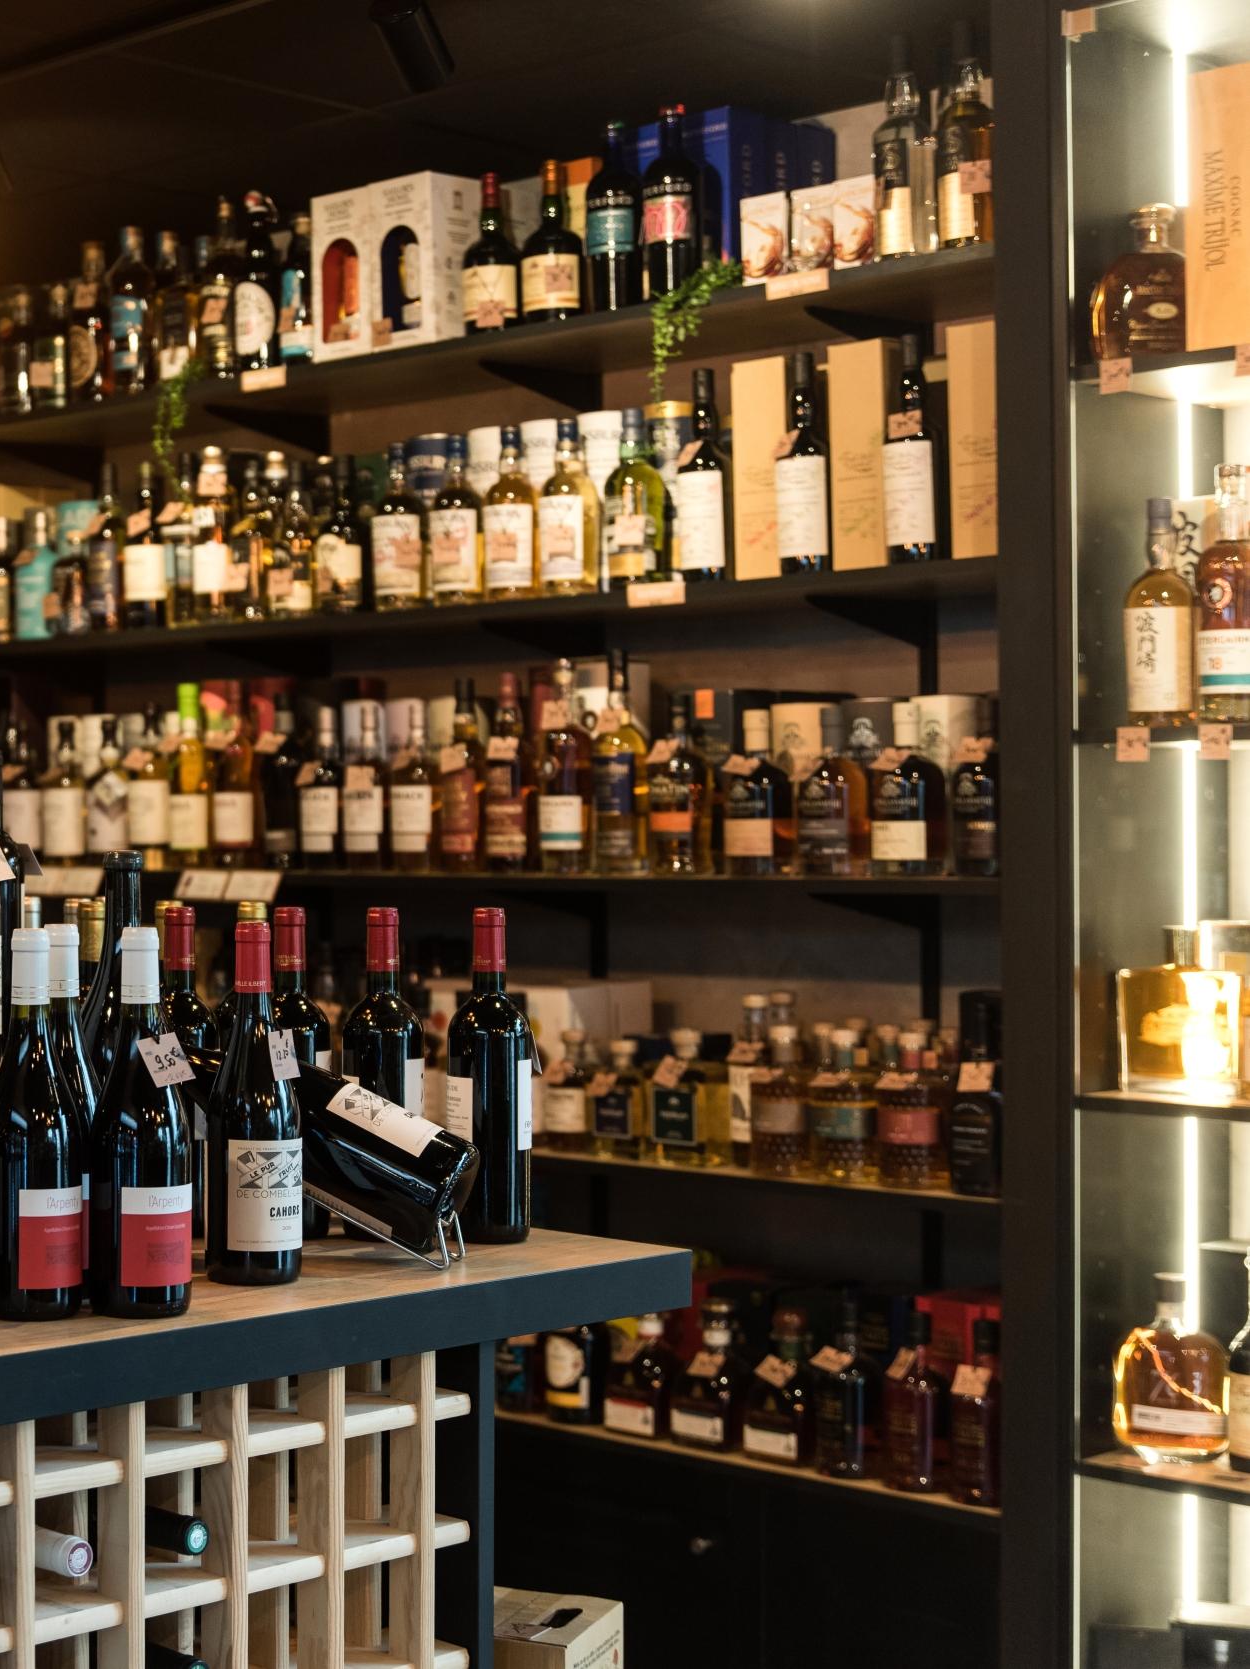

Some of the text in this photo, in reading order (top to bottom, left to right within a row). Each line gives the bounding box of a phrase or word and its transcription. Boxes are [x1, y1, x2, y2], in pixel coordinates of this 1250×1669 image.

[1203, 151, 1226, 216] MAXIME
[1229, 175, 1243, 236] COGNAC
[250, 1170, 259, 1179] LE
[260, 1161, 276, 1173] PUR
[279, 1163, 295, 1179] FRUIT
[237, 1189, 250, 1199] DE
[269, 1204, 300, 1218] CAHORS
